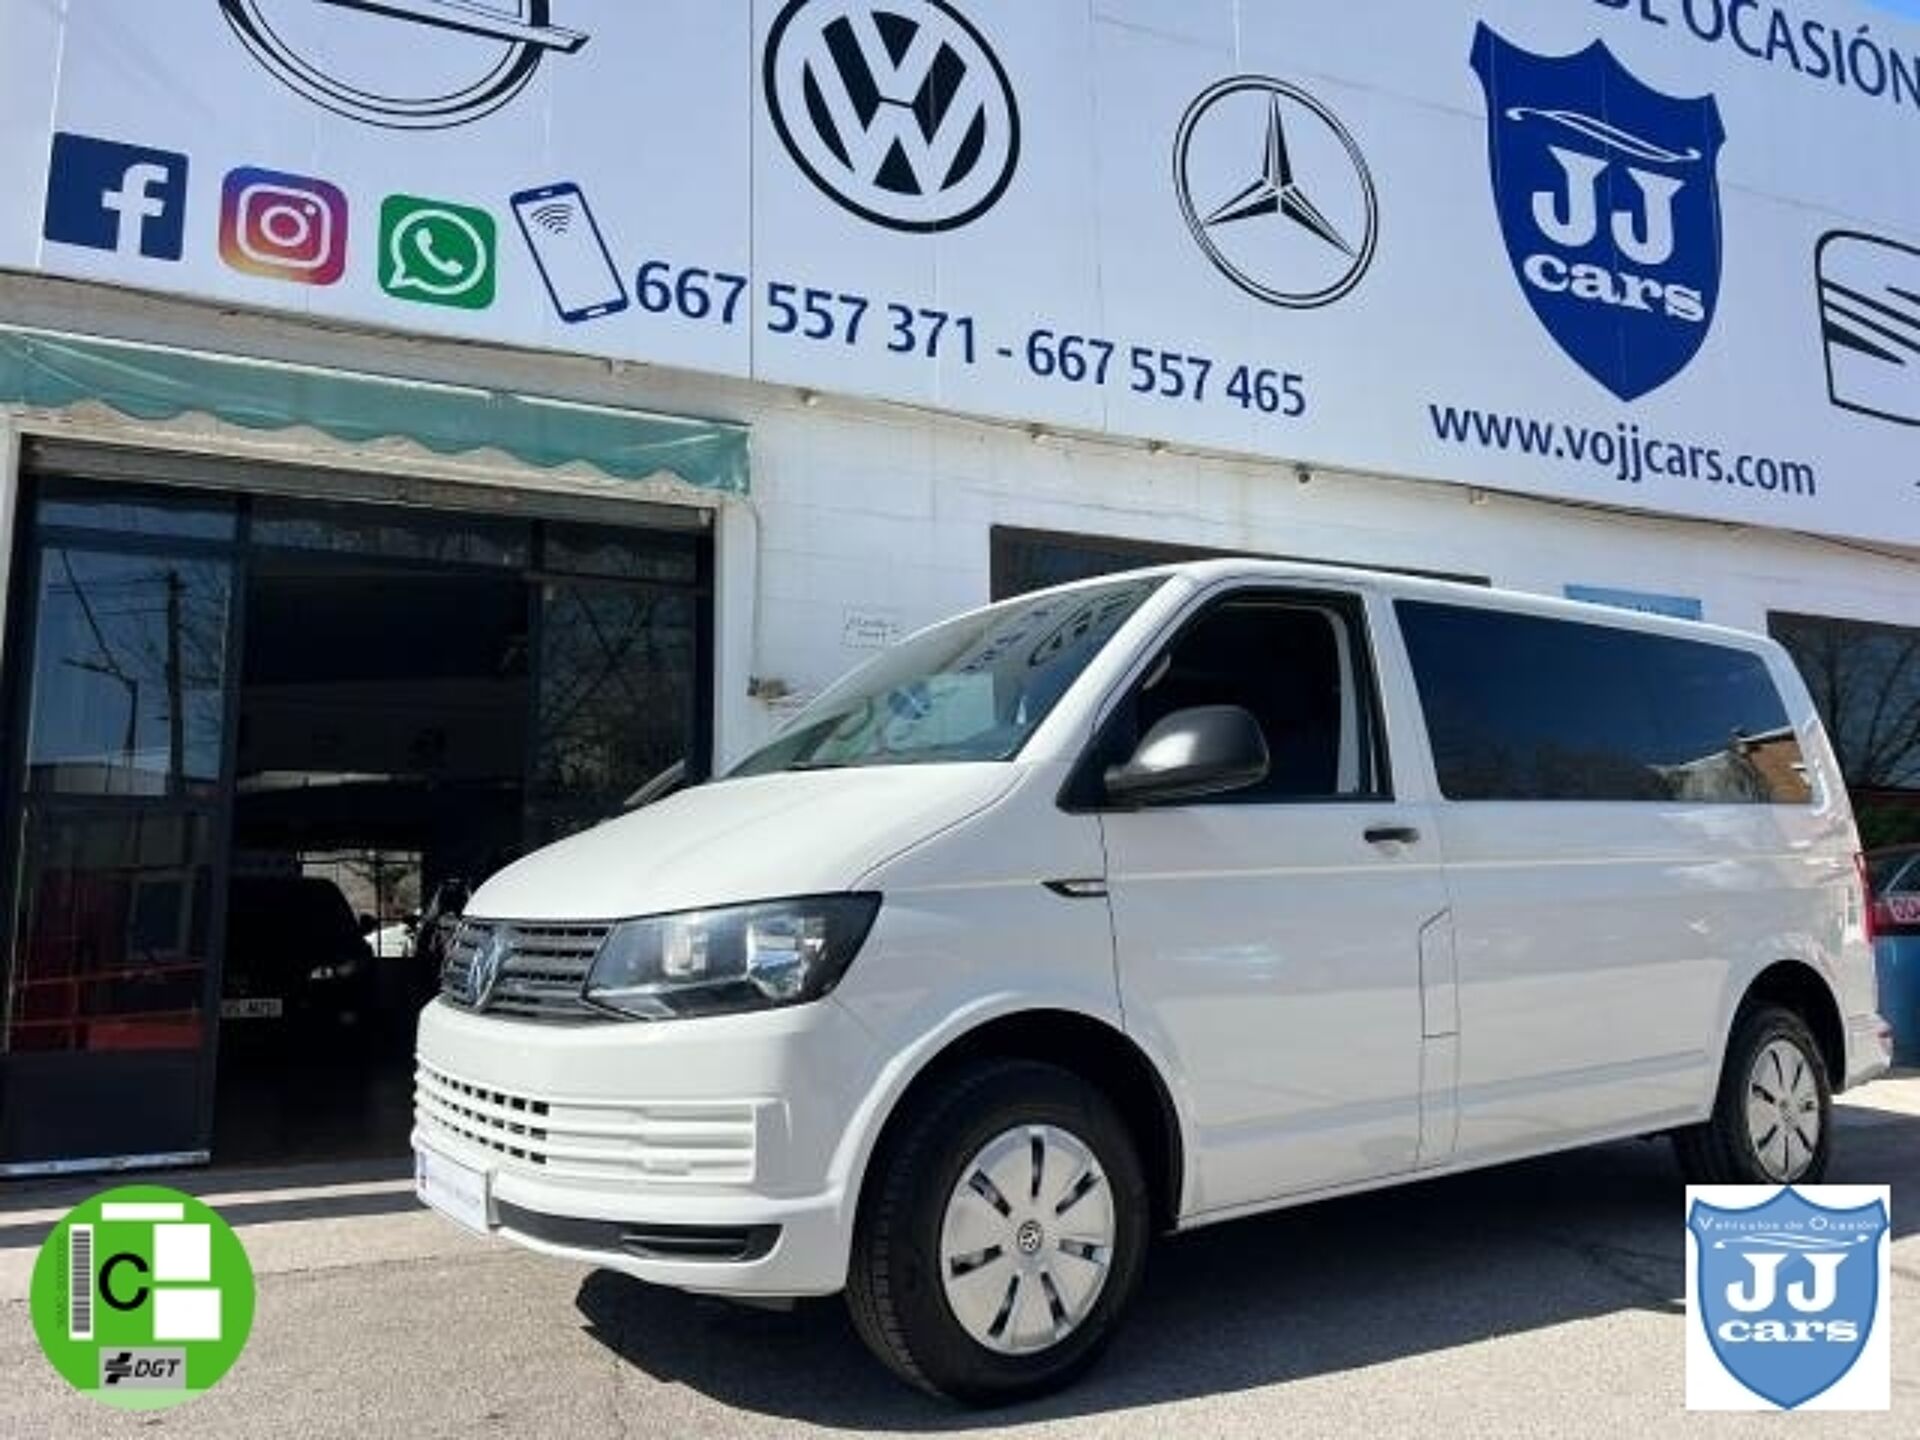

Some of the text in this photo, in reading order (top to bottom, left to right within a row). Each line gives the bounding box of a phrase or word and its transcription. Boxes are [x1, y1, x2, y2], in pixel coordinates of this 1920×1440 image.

[1532, 145, 1686, 265] JJ
[635, 260, 748, 324] 667
[767, 281, 868, 345] 557
[887, 303, 975, 364] 371
[1026, 329, 1114, 385] 667
[1130, 347, 1212, 401] 557
[1226, 365, 1306, 417] 465
[1523, 254, 1705, 322] cars
[1430, 403, 1816, 496] www.vojjcars.com
